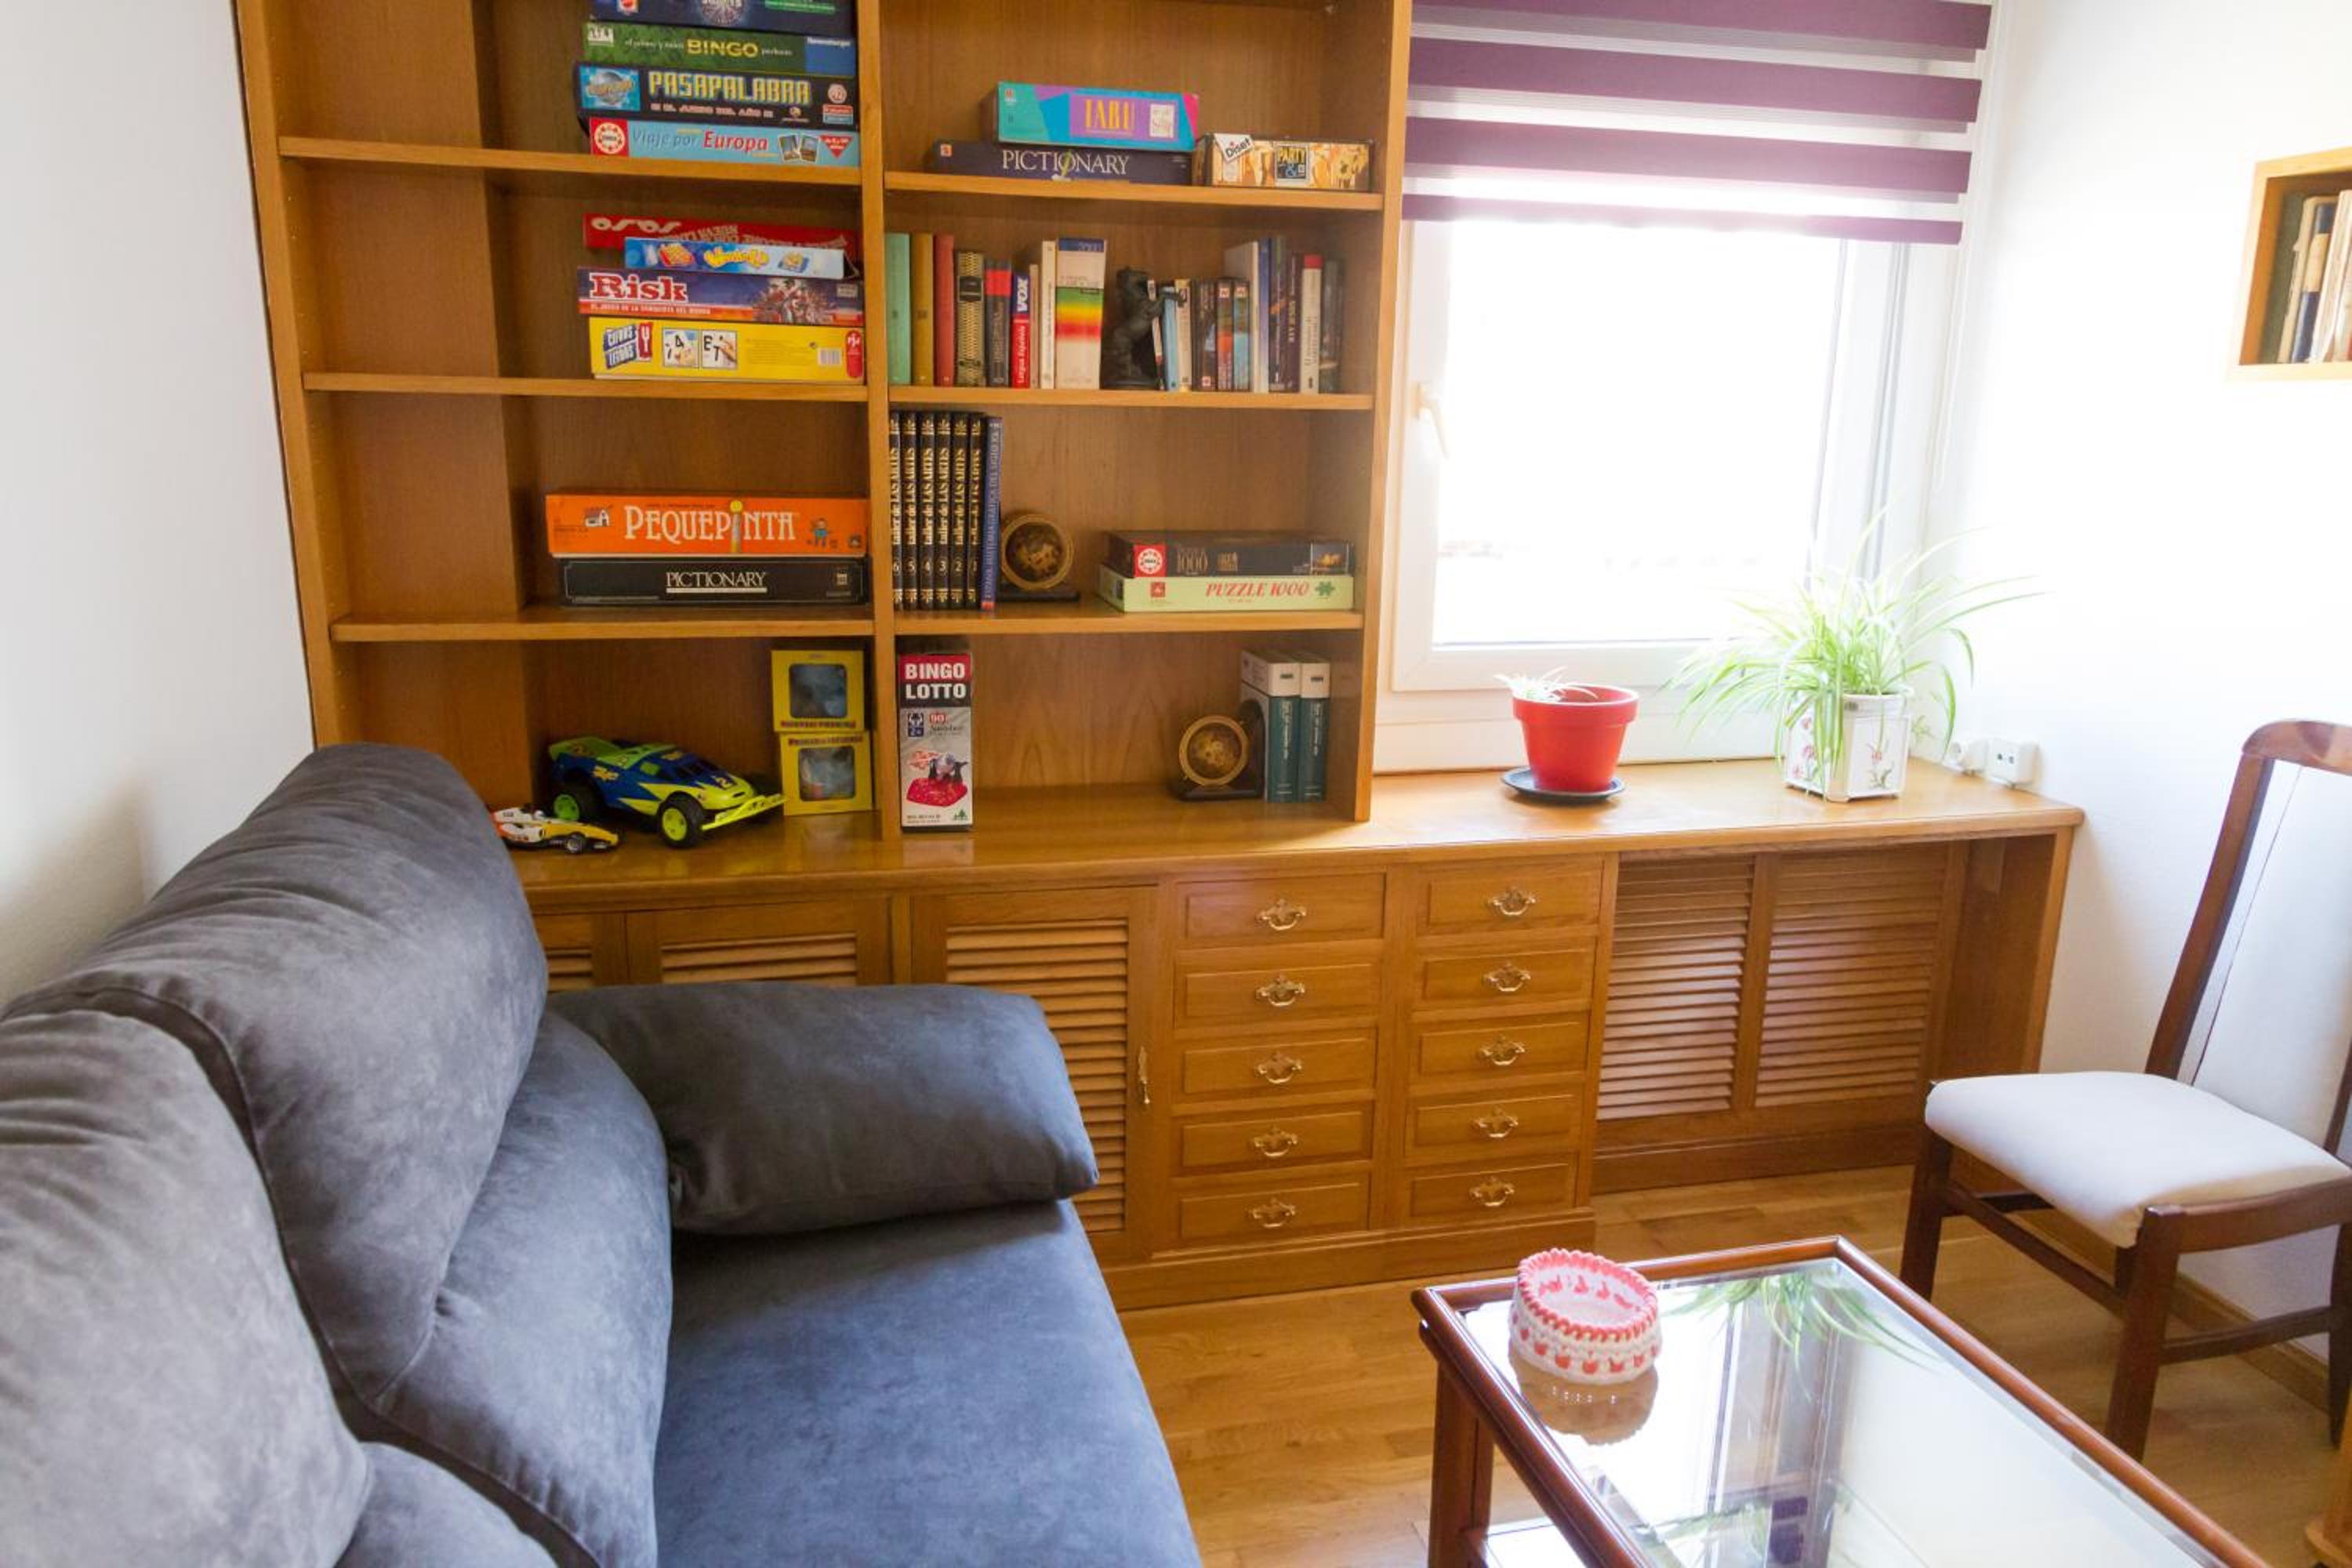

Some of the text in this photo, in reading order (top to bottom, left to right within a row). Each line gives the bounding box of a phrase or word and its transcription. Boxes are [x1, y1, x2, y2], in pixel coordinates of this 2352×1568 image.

[687, 39, 758, 58] BINGO
[648, 70, 811, 106] PASAPALABRA
[672, 134, 699, 147] por
[702, 130, 768, 152] Europa
[1226, 138, 1251, 158] Diset
[1001, 150, 1129, 175] PICTIONARY
[590, 273, 688, 303] Risk
[1016, 276, 1029, 312] VOX
[903, 482, 915, 503] LAS
[920, 482, 932, 503] LAS
[938, 482, 949, 503] LAS
[954, 482, 964, 503] LAS
[666, 572, 766, 587] PICTIONARY
[1205, 581, 1267, 597] PUZZLE
[905, 662, 966, 680] BINGO
[906, 683, 967, 699] LOTTO
